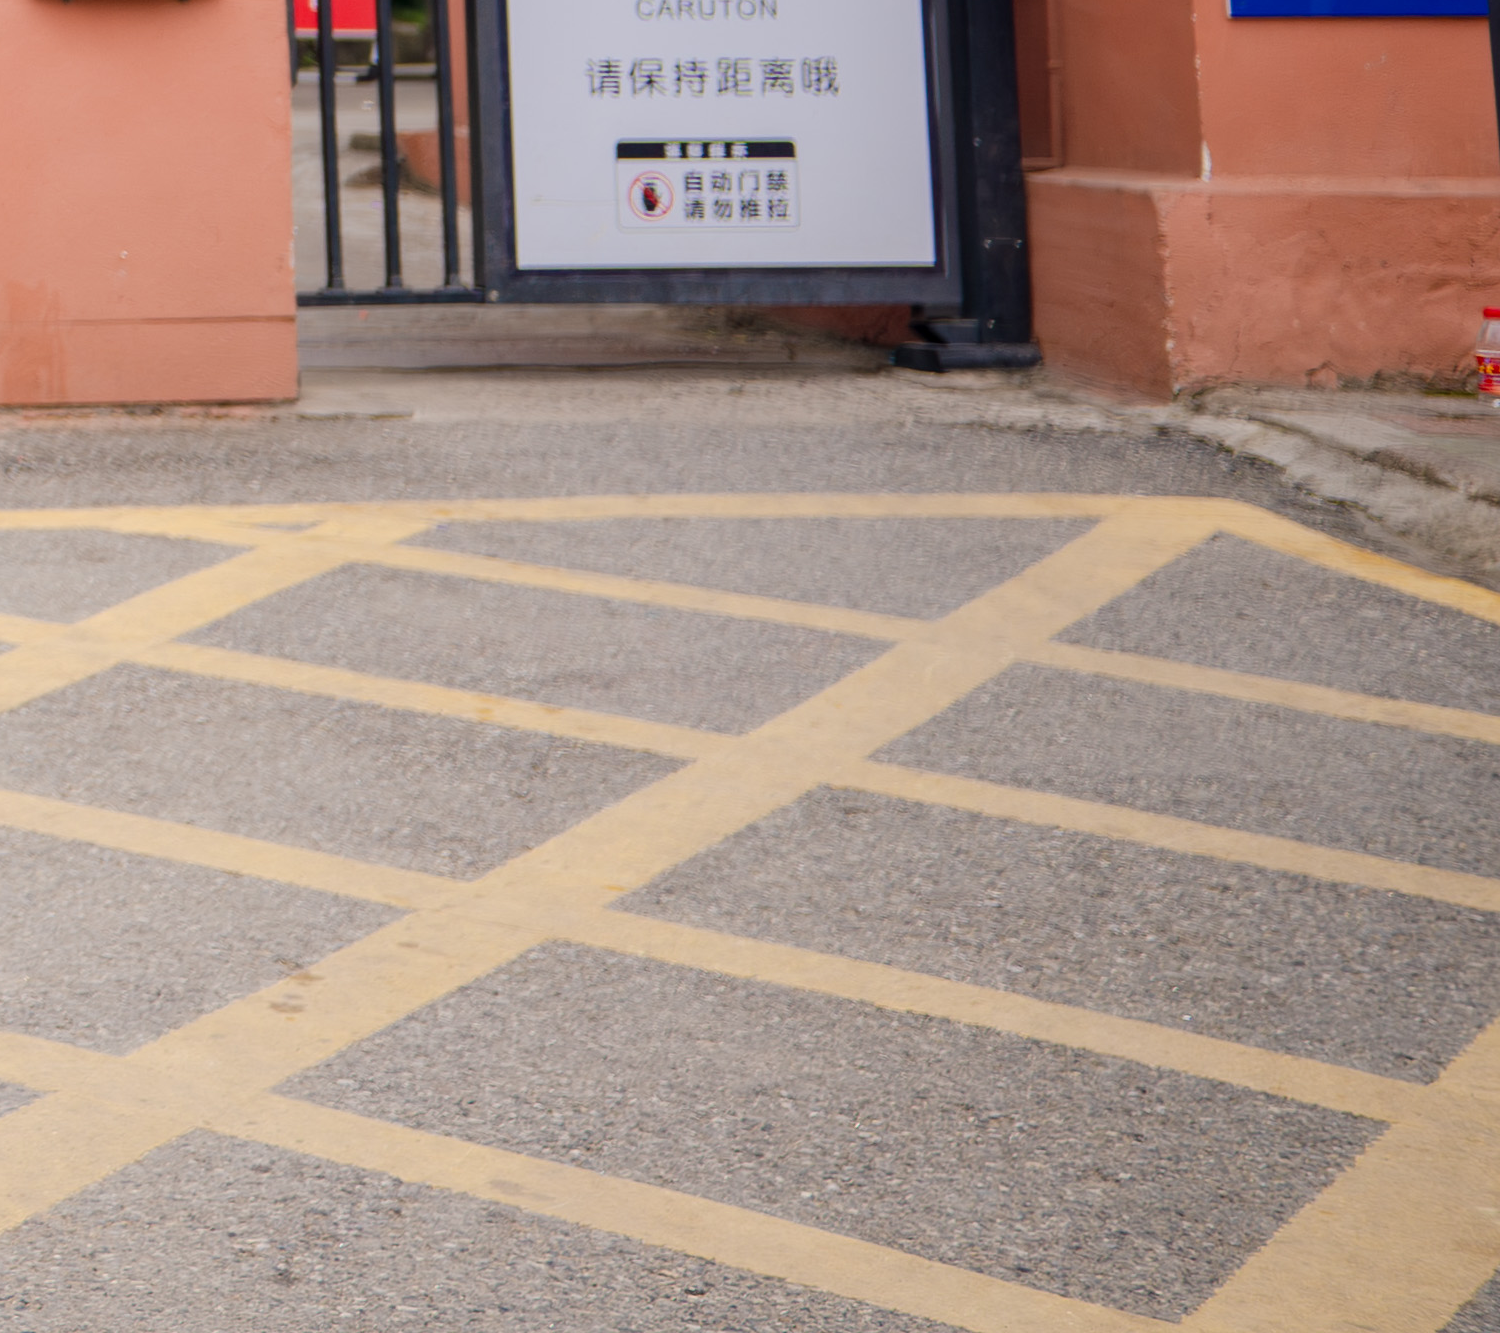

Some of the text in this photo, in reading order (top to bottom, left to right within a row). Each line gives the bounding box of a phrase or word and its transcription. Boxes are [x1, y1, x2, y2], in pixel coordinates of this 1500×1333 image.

[584, 56, 841, 99] 请保持距离哦
[683, 169, 790, 194] 自动门禁
